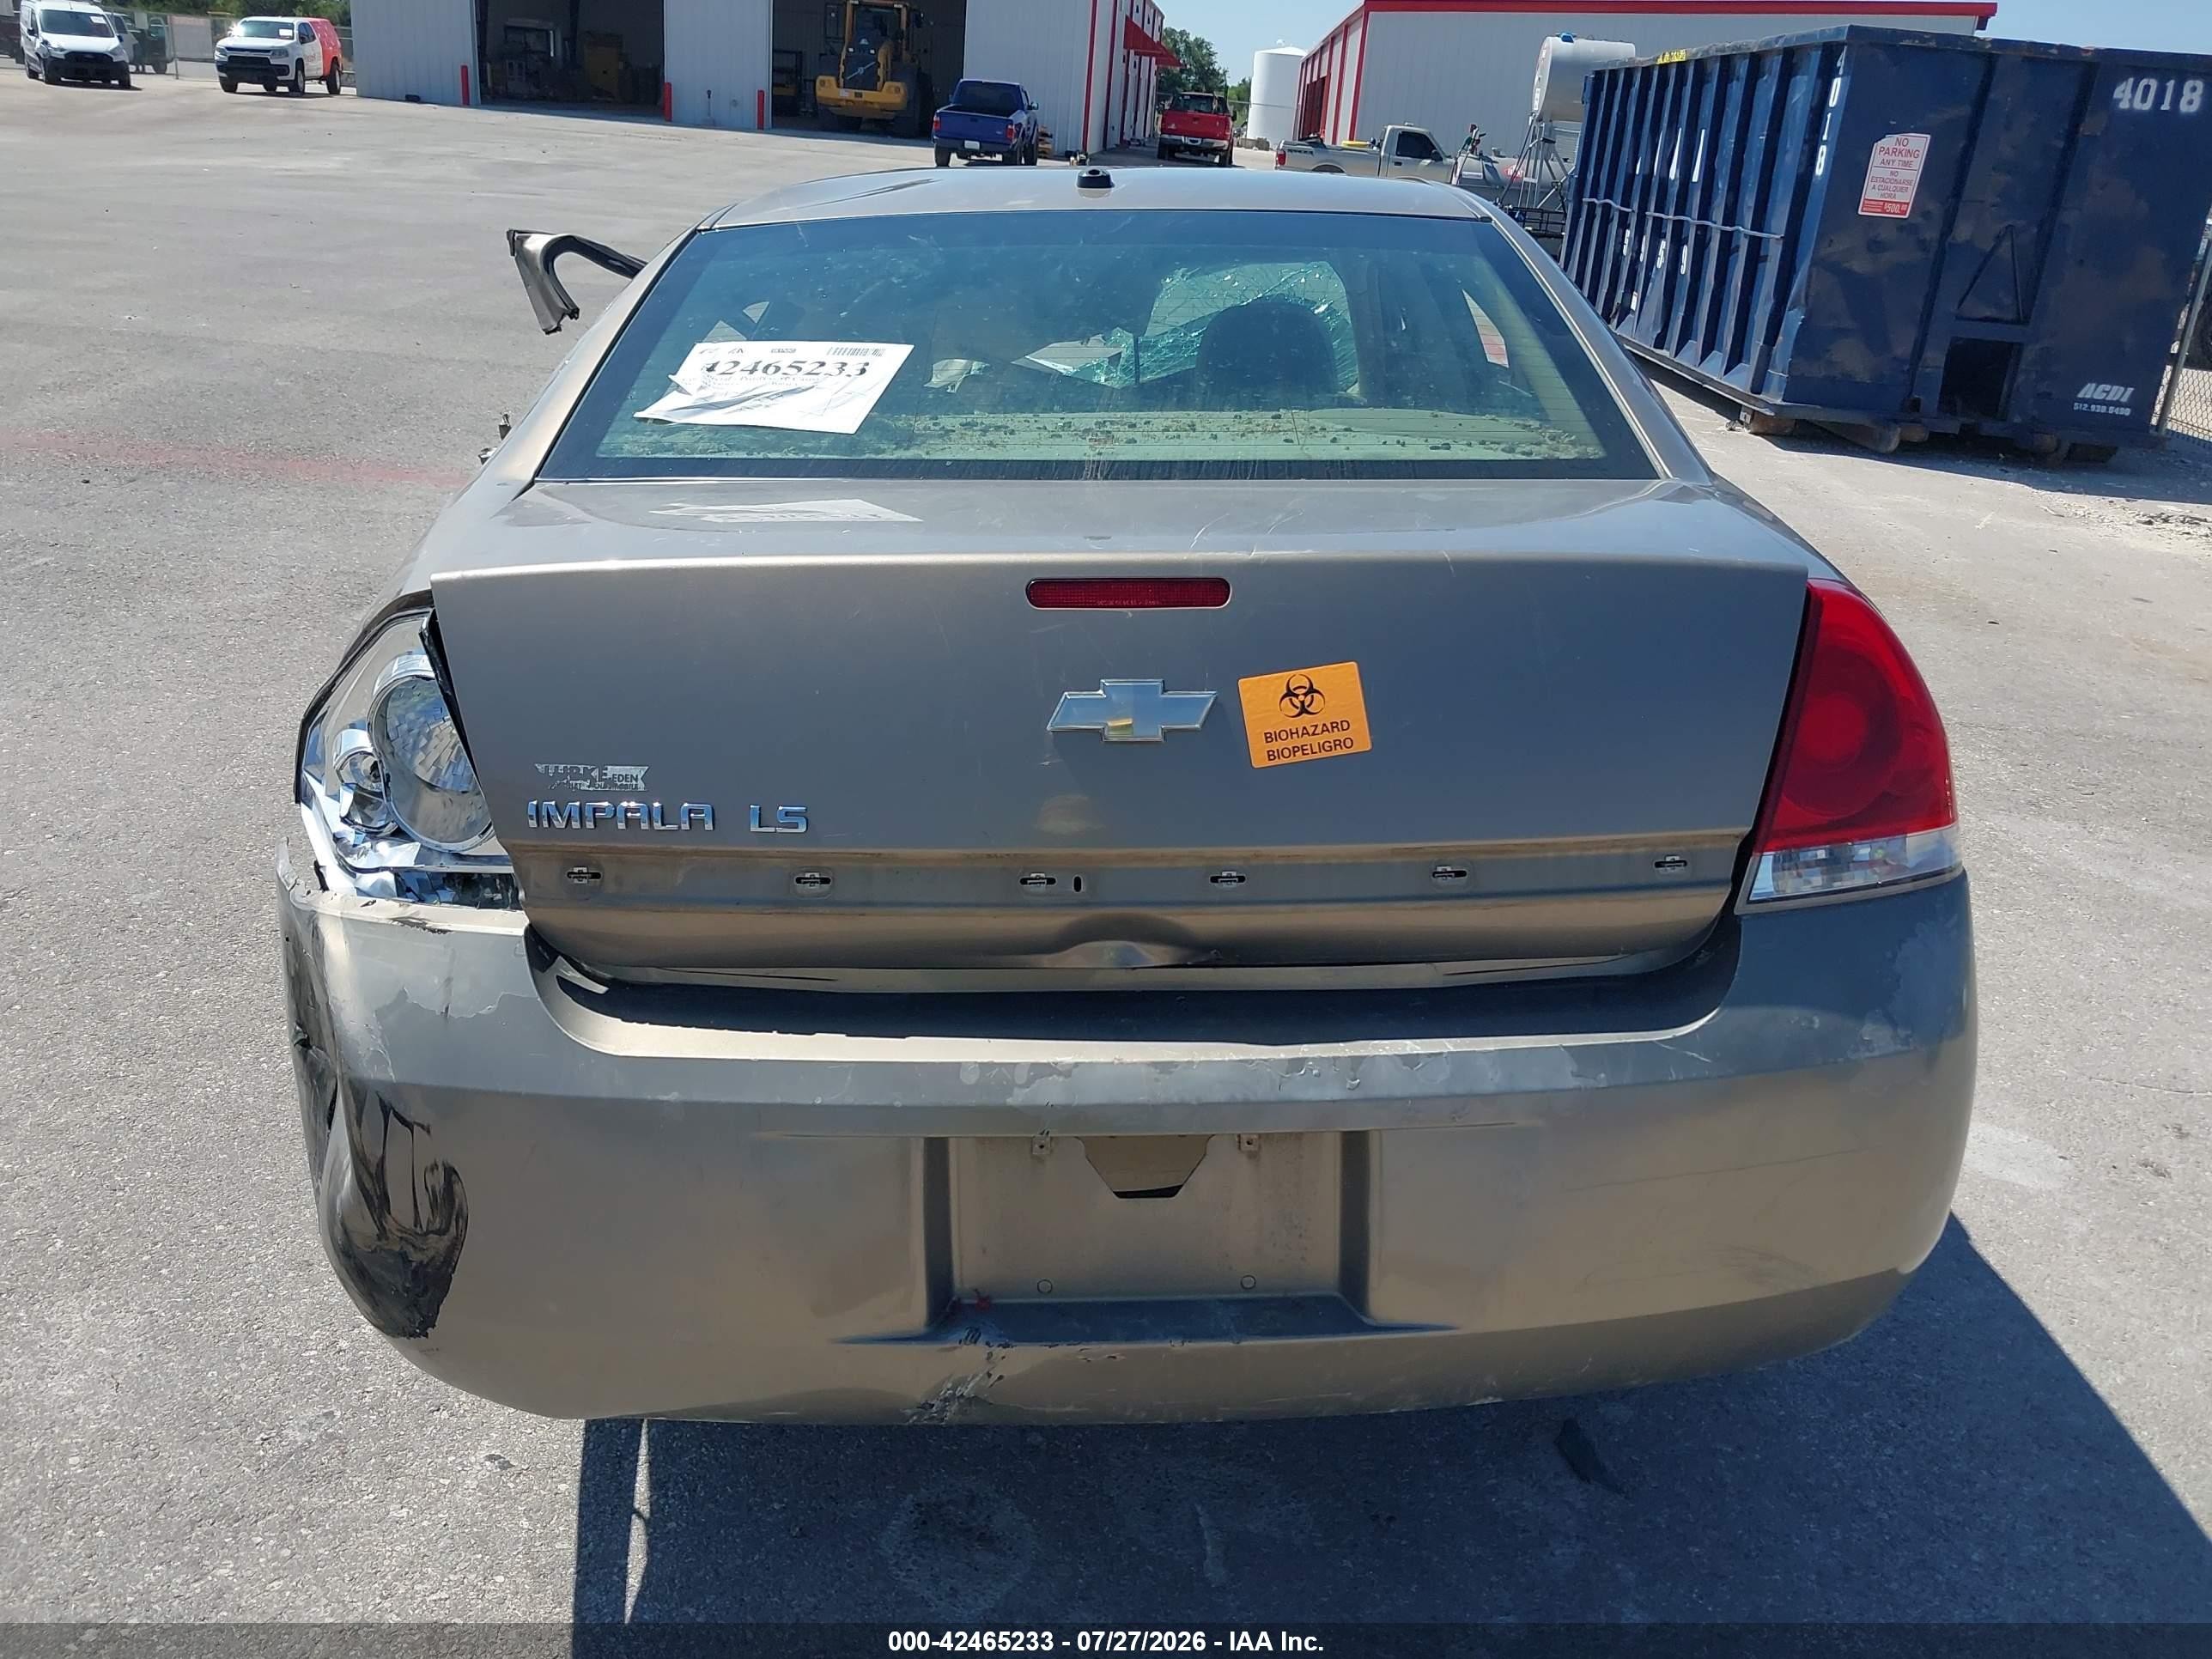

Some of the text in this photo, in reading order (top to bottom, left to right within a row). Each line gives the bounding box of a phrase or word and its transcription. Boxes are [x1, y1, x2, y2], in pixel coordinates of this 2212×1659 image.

[2112, 77, 2204, 113] 4018
[1878, 146, 1920, 159] PARKING
[1894, 137, 1909, 147] NO
[1898, 159, 1913, 167] TIME
[2076, 382, 2135, 403] ACDI
[1264, 720, 1351, 744] BIOHAZARD
[1267, 737, 1354, 762] BIOPELIGRO
[527, 799, 809, 833] IMPALA LS
